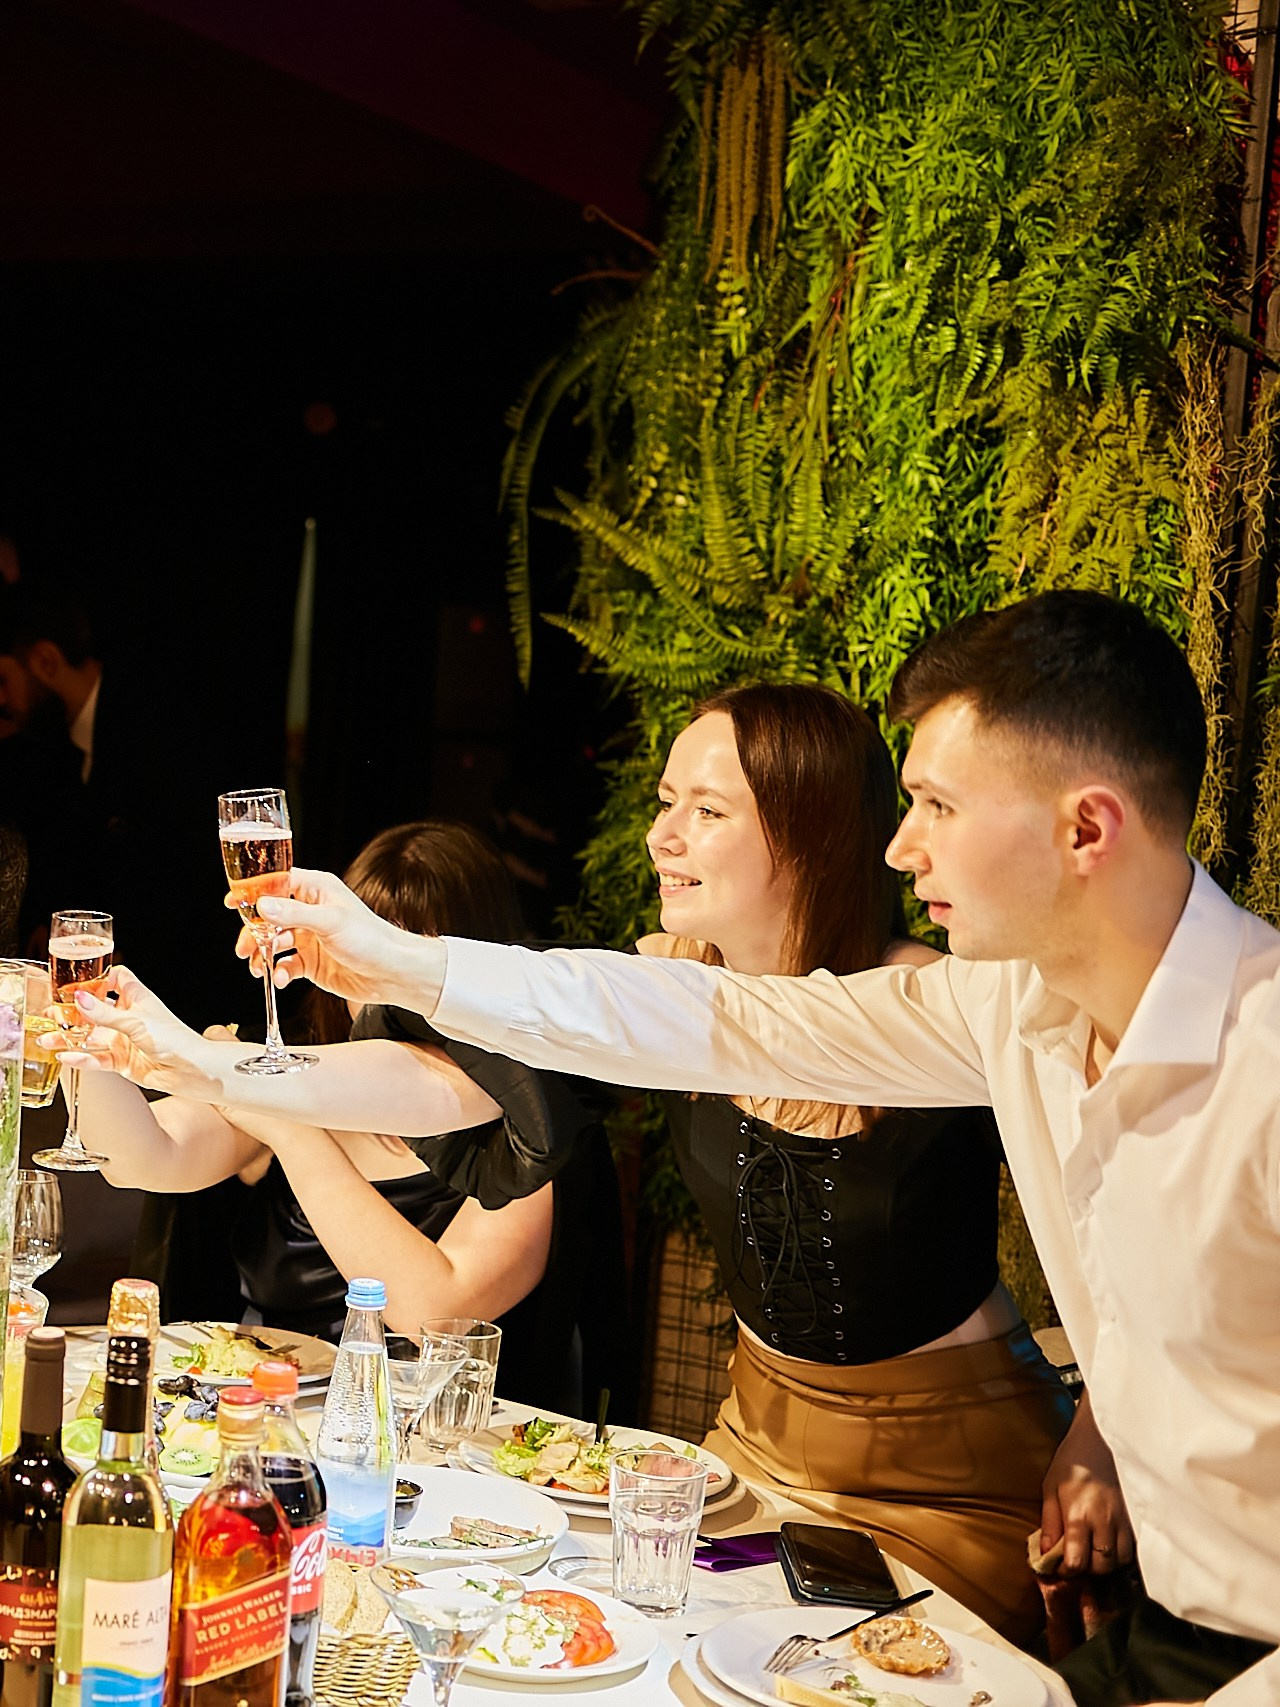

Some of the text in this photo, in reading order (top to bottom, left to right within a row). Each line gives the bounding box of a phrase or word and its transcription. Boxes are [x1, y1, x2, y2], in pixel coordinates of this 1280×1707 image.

[92, 1609, 140, 1629] MARÉ
[195, 1621, 231, 1644] RED
[234, 1601, 287, 1631] LABEL
